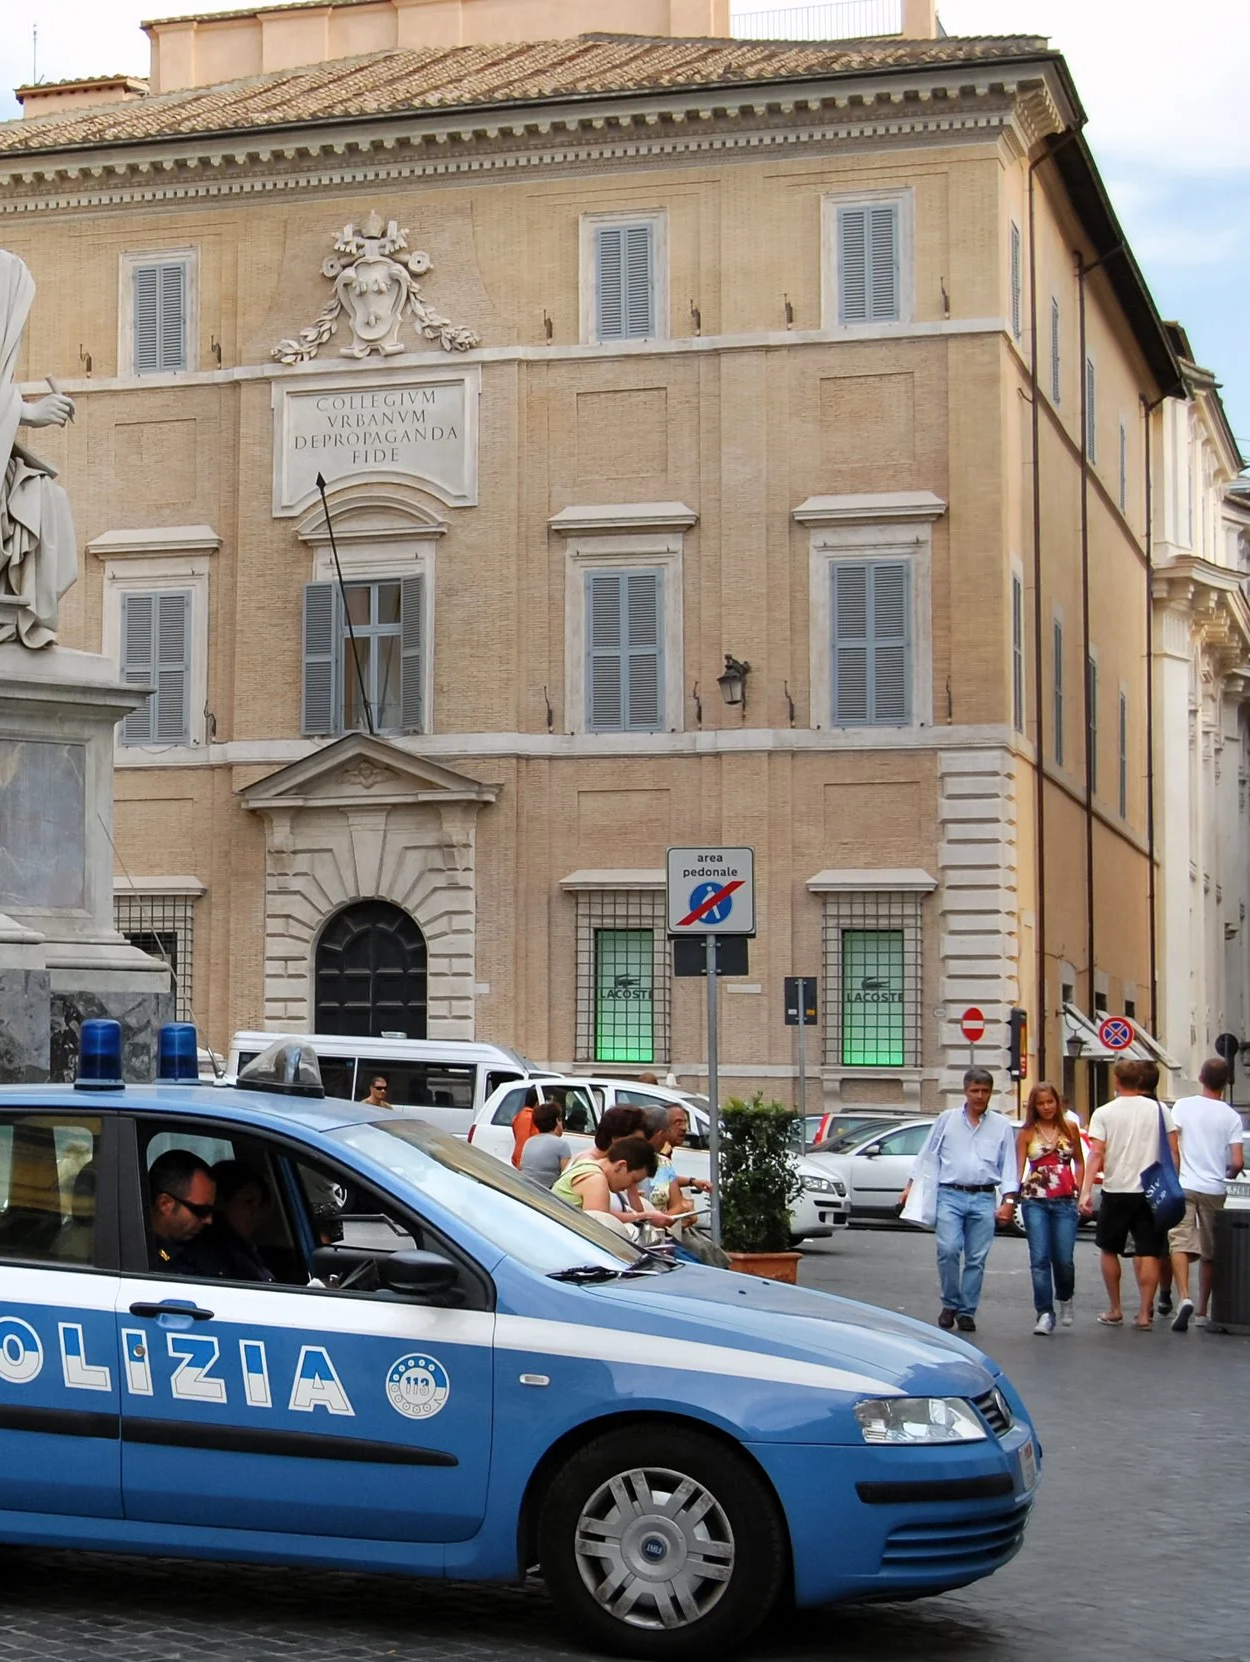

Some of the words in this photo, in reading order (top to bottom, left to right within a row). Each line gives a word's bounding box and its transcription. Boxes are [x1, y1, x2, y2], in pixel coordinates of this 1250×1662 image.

[316, 390, 435, 412] COLLEGIVM
[327, 409, 426, 428] VRBANVM
[352, 448, 399, 464] FIDE
[683, 867, 738, 878] pedonale
[405, 1376, 430, 1396] 113
